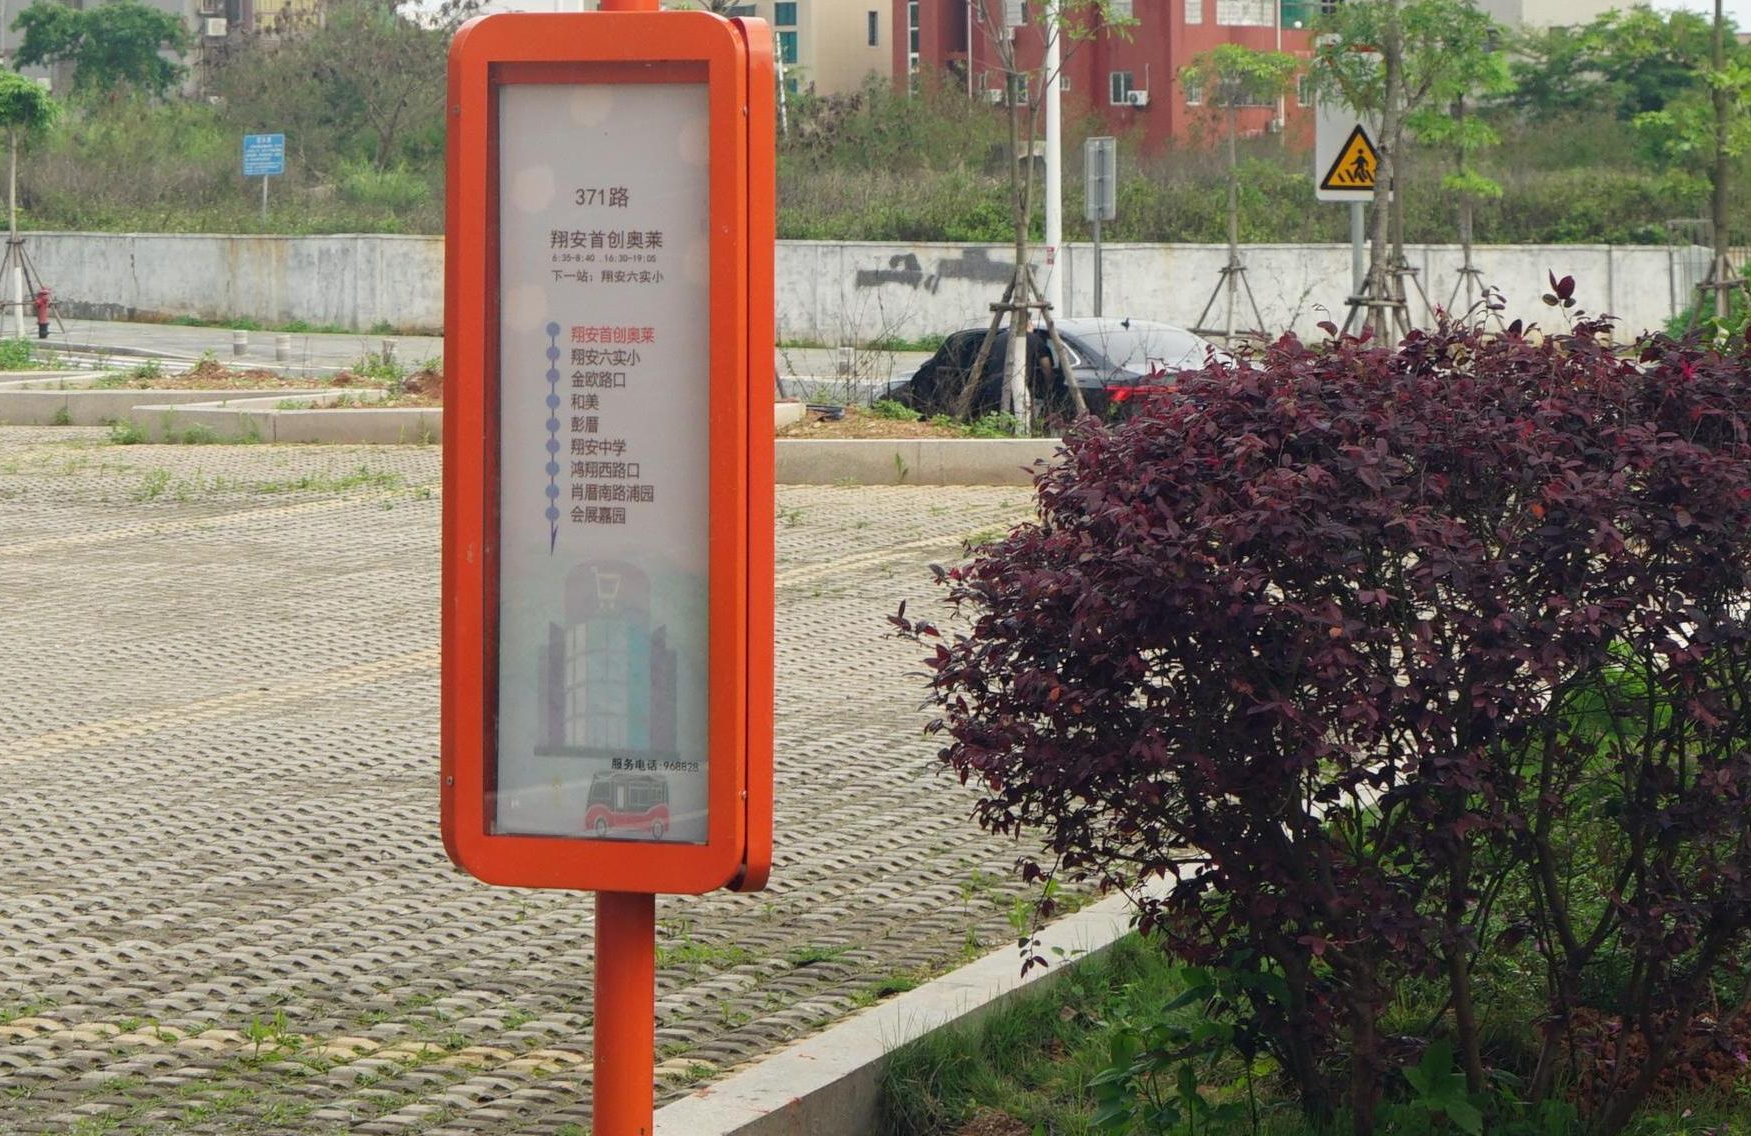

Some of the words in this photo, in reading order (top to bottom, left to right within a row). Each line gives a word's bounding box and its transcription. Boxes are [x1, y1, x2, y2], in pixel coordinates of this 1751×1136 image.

[575, 186, 629, 208] 371路
[550, 229, 663, 250] 翔安首创奥莱
[571, 326, 655, 344] 翔安首创奥莱
[570, 348, 641, 366] 翔安六实小
[570, 370, 626, 389] 金欧路口
[570, 393, 599, 411] 和美
[570, 438, 627, 457] 翔安中学
[570, 460, 640, 479] 鸿翔西路口
[570, 505, 626, 525] 会展嘉园
